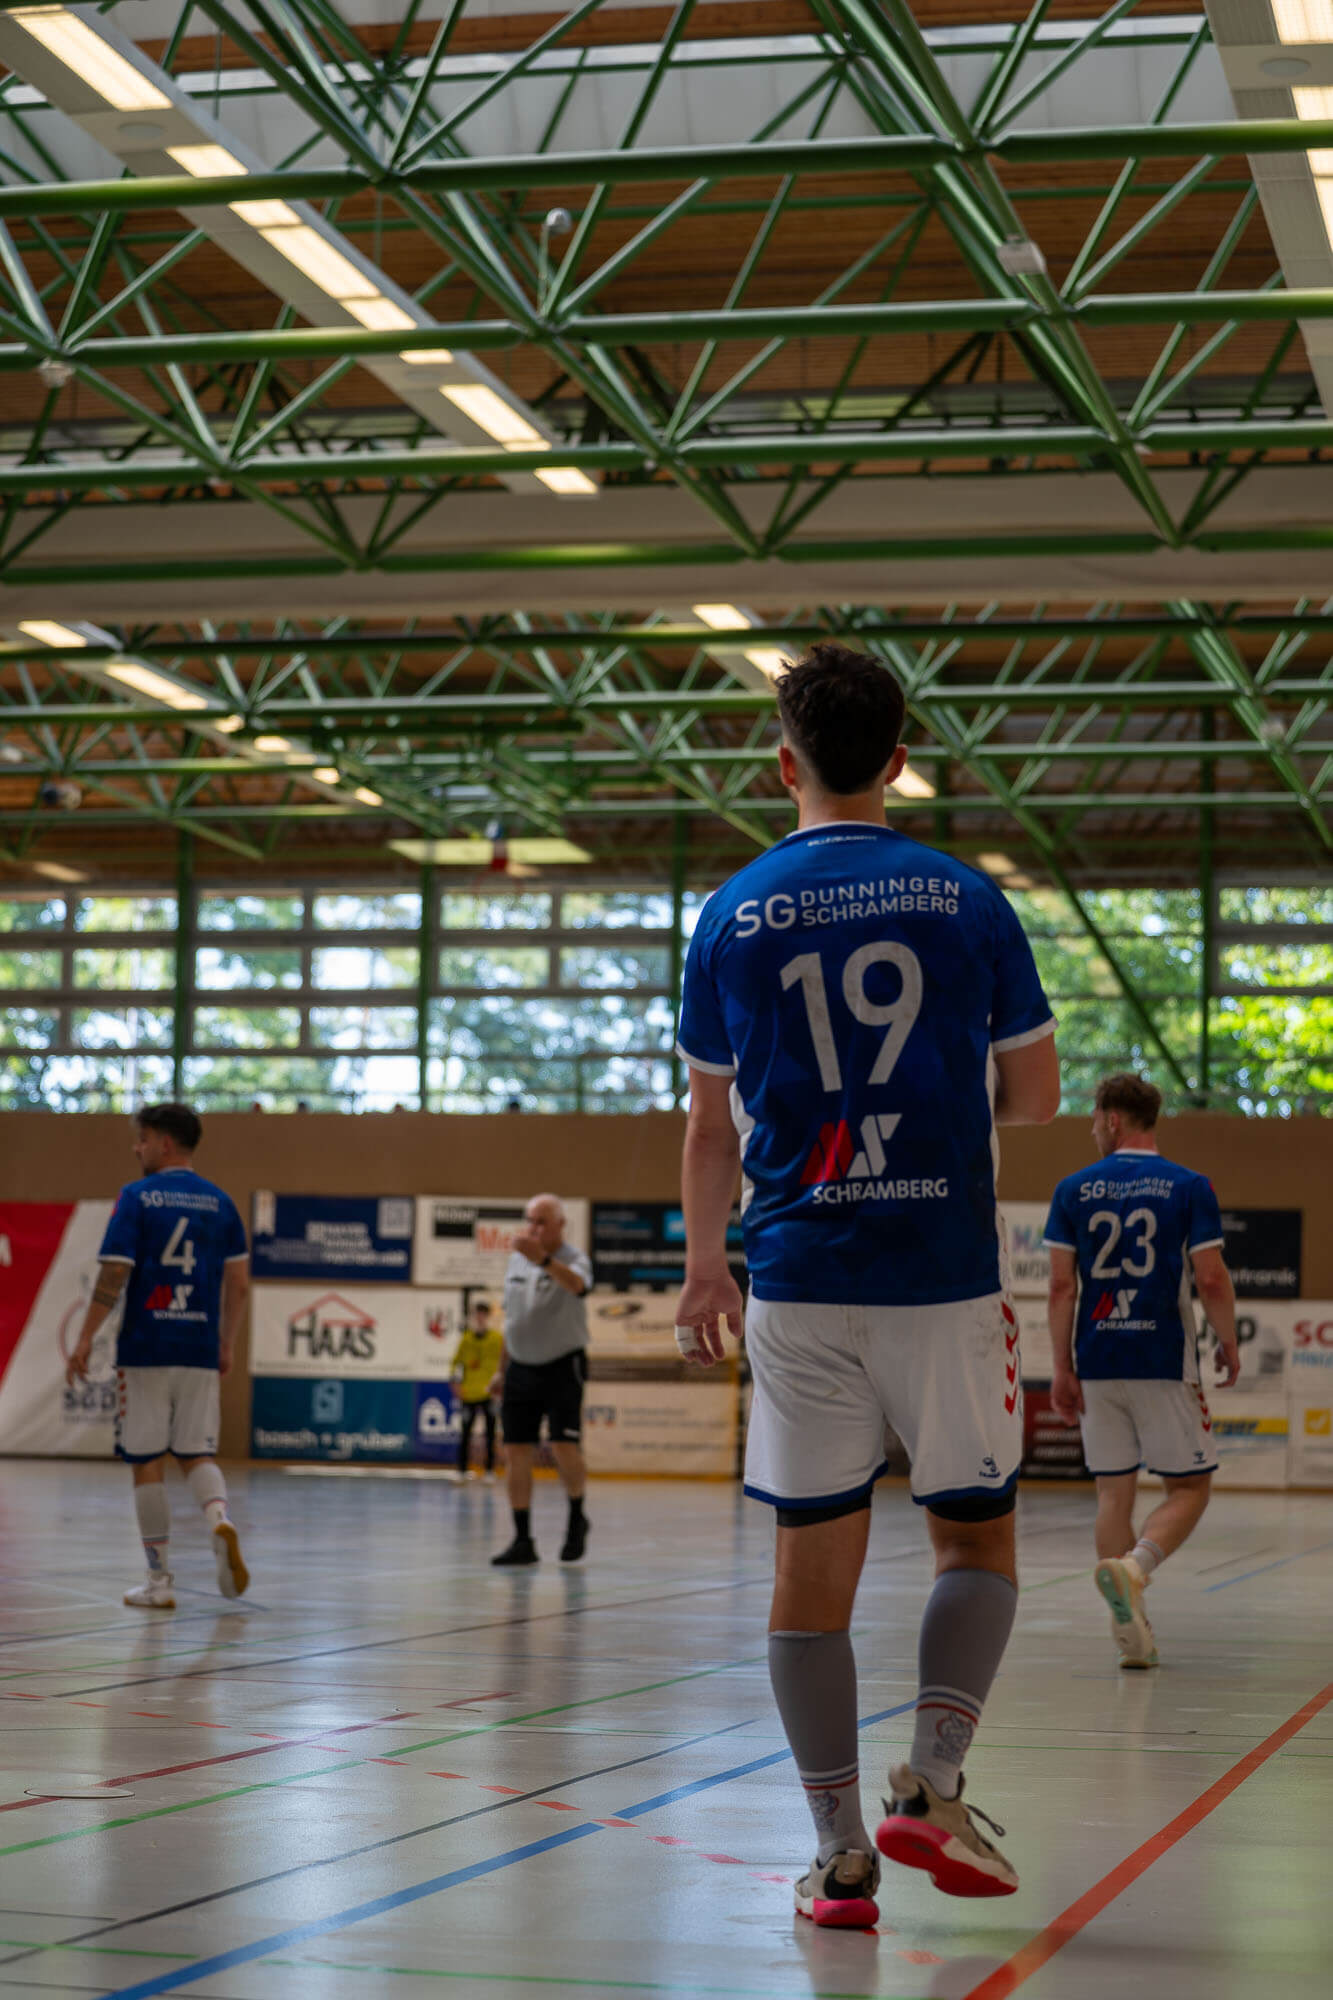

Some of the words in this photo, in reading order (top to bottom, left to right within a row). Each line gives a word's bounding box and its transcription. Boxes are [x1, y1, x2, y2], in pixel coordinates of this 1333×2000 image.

[800, 876, 960, 908] DUNNINGEN
[802, 893, 959, 927] SCHRAMBERG
[735, 893, 797, 938] SG
[779, 940, 924, 1092] 19
[813, 1177, 949, 1205] SCHRAMBERG
[1079, 1179, 1106, 1202] SG
[160, 1216, 197, 1276] 4
[1088, 1208, 1158, 1280] 23
[288, 1308, 376, 1359] HAAS
